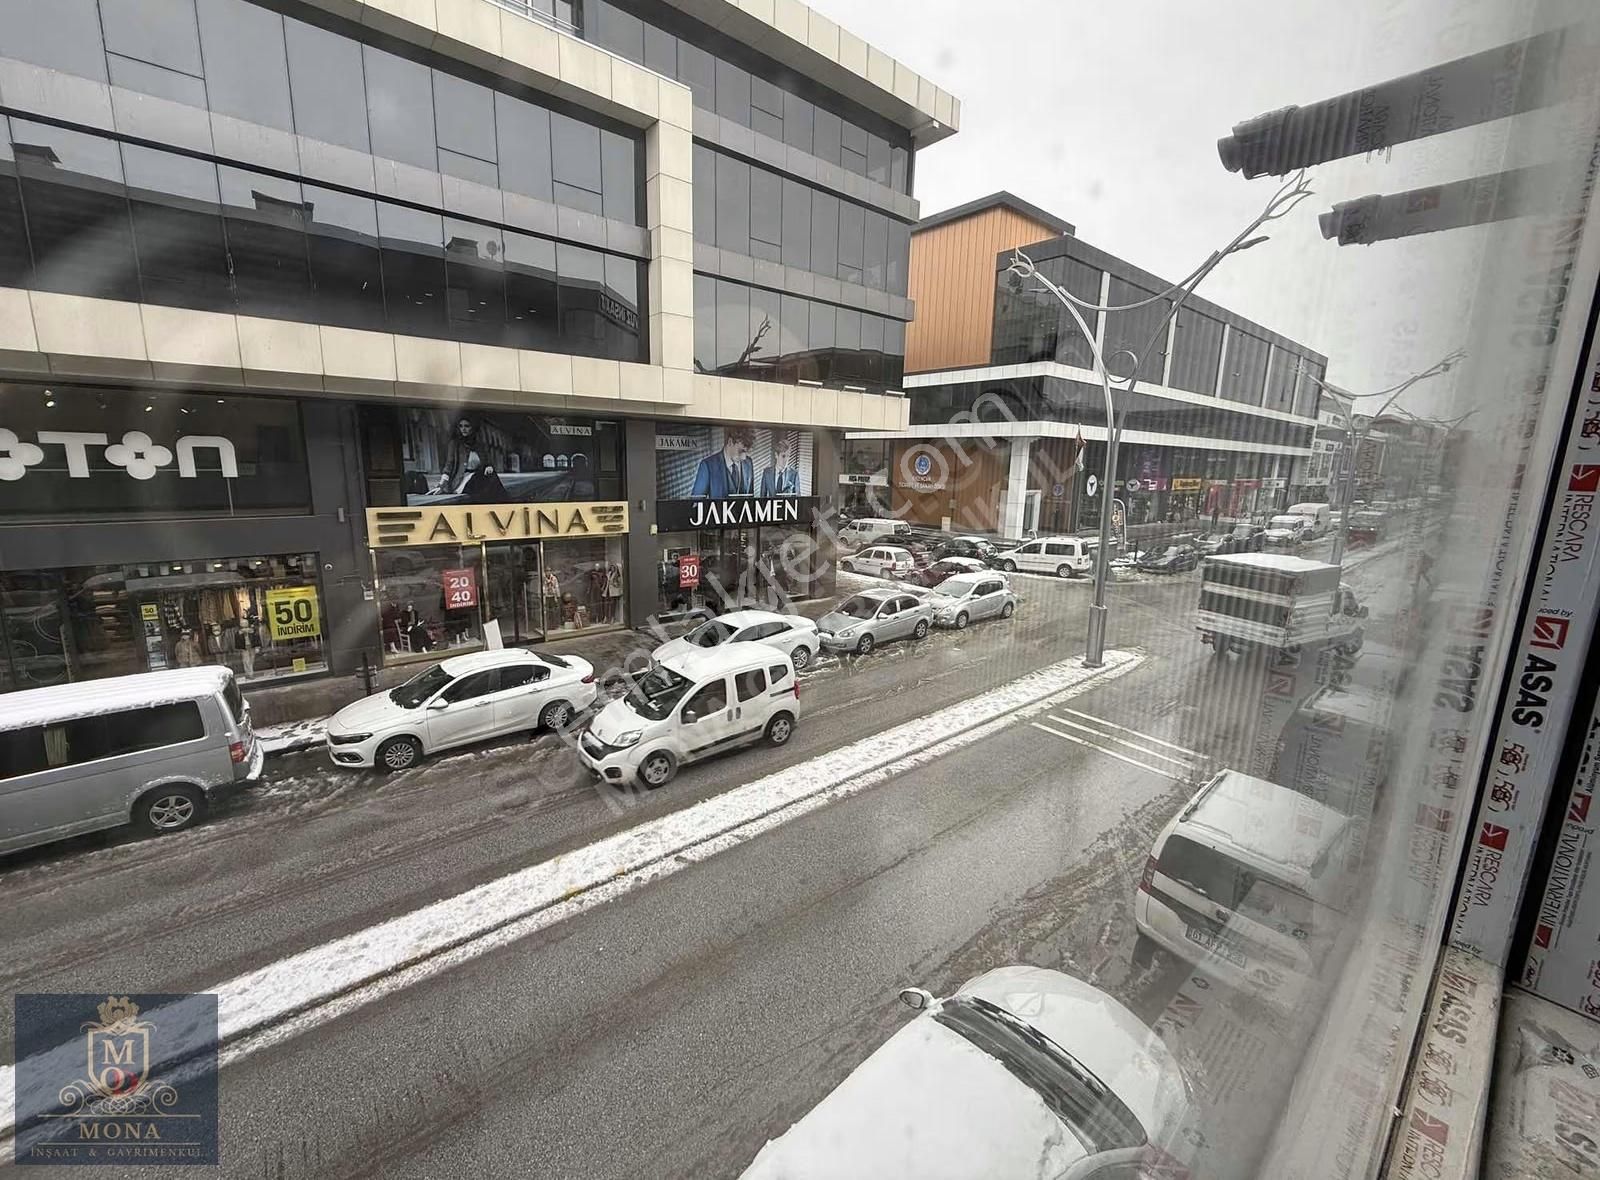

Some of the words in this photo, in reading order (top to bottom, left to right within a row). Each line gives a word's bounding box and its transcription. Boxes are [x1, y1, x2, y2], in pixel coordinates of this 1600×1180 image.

[690, 499, 798, 526] JAKAMEN
[429, 506, 589, 541] ALVİNA
[681, 564, 698, 578] 30
[450, 576, 469, 589] 20
[451, 590, 471, 602] 40
[275, 598, 312, 625] 50
[277, 622, 315, 637] İNDİRİM
[1541, 833, 1580, 926] INTERNATIONAL
